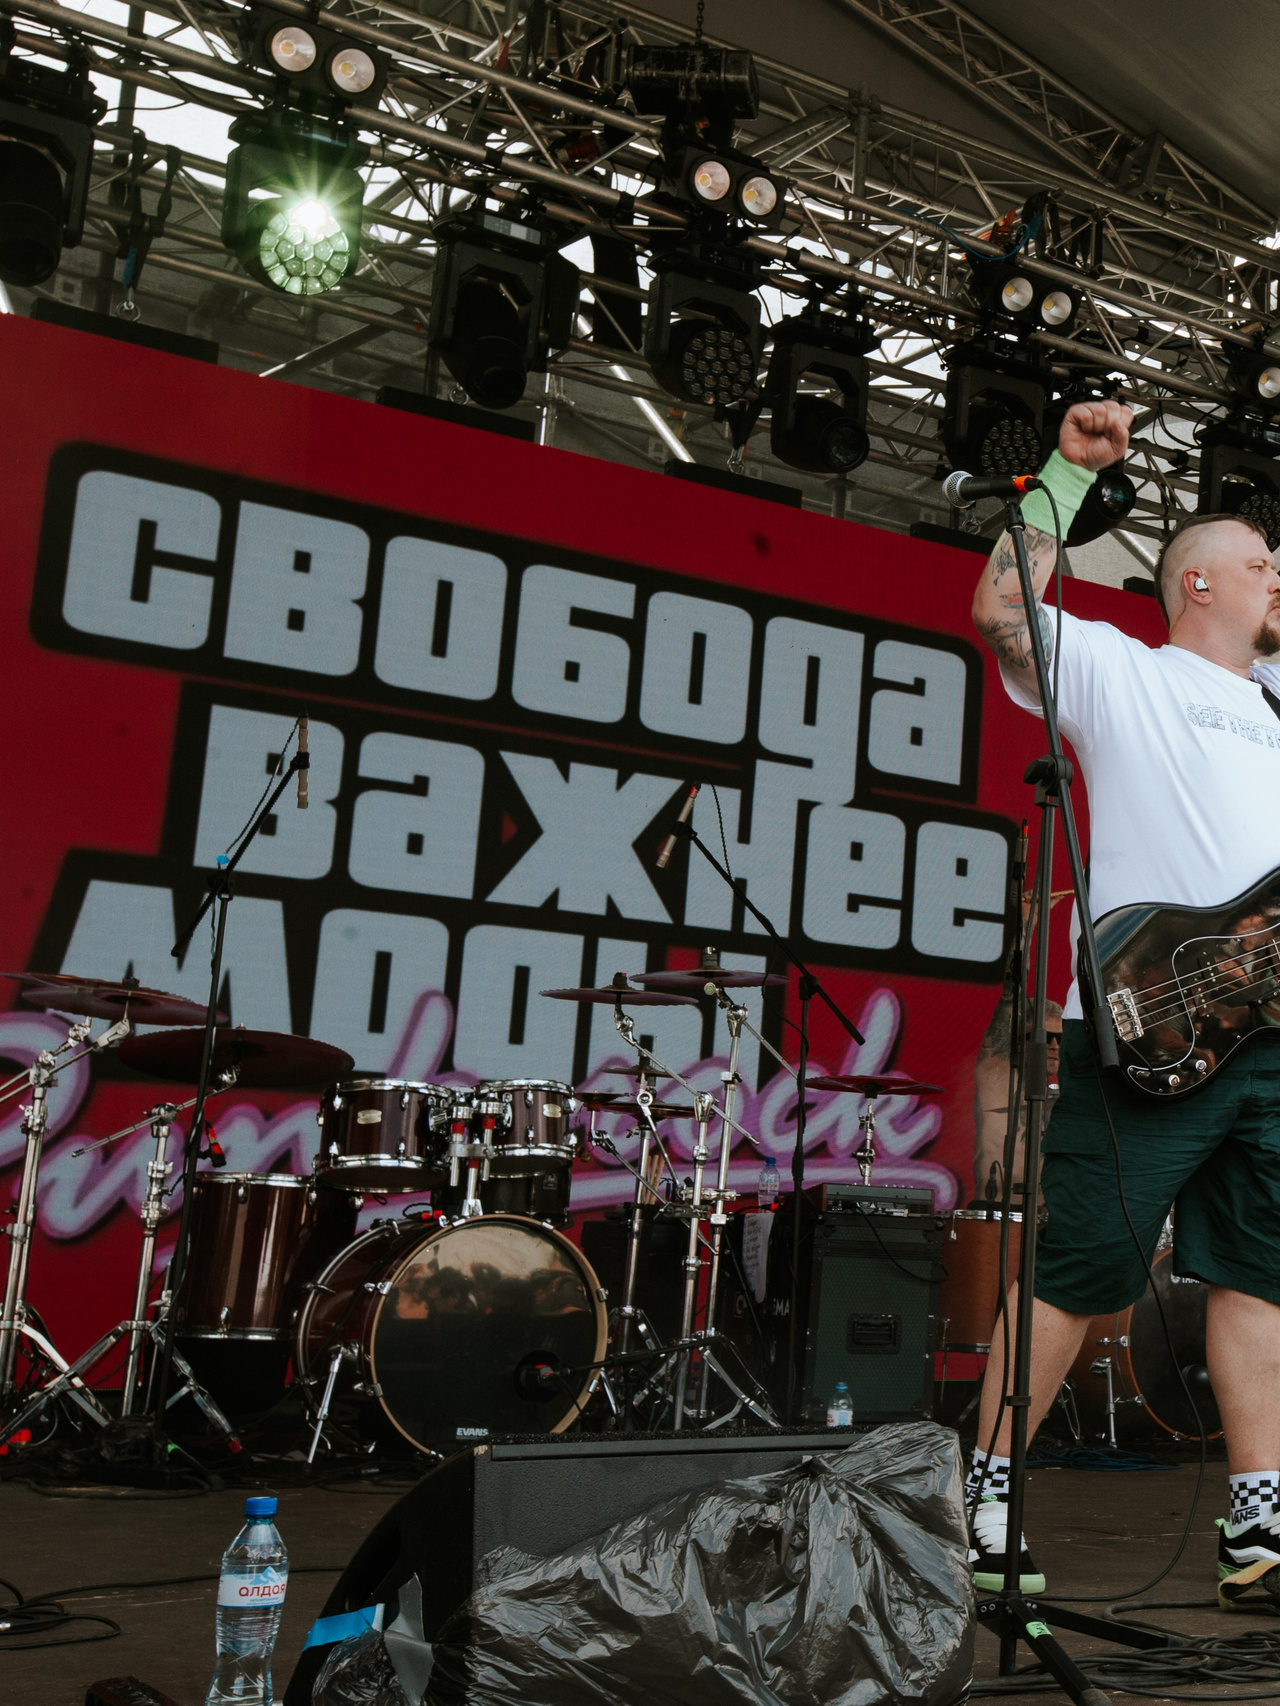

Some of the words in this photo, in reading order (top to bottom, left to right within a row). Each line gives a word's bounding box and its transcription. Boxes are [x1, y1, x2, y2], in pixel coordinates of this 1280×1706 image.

[1183, 702, 1226, 731] SEE
[1223, 710, 1263, 744] THE
[456, 1427, 489, 1436] EVANS
